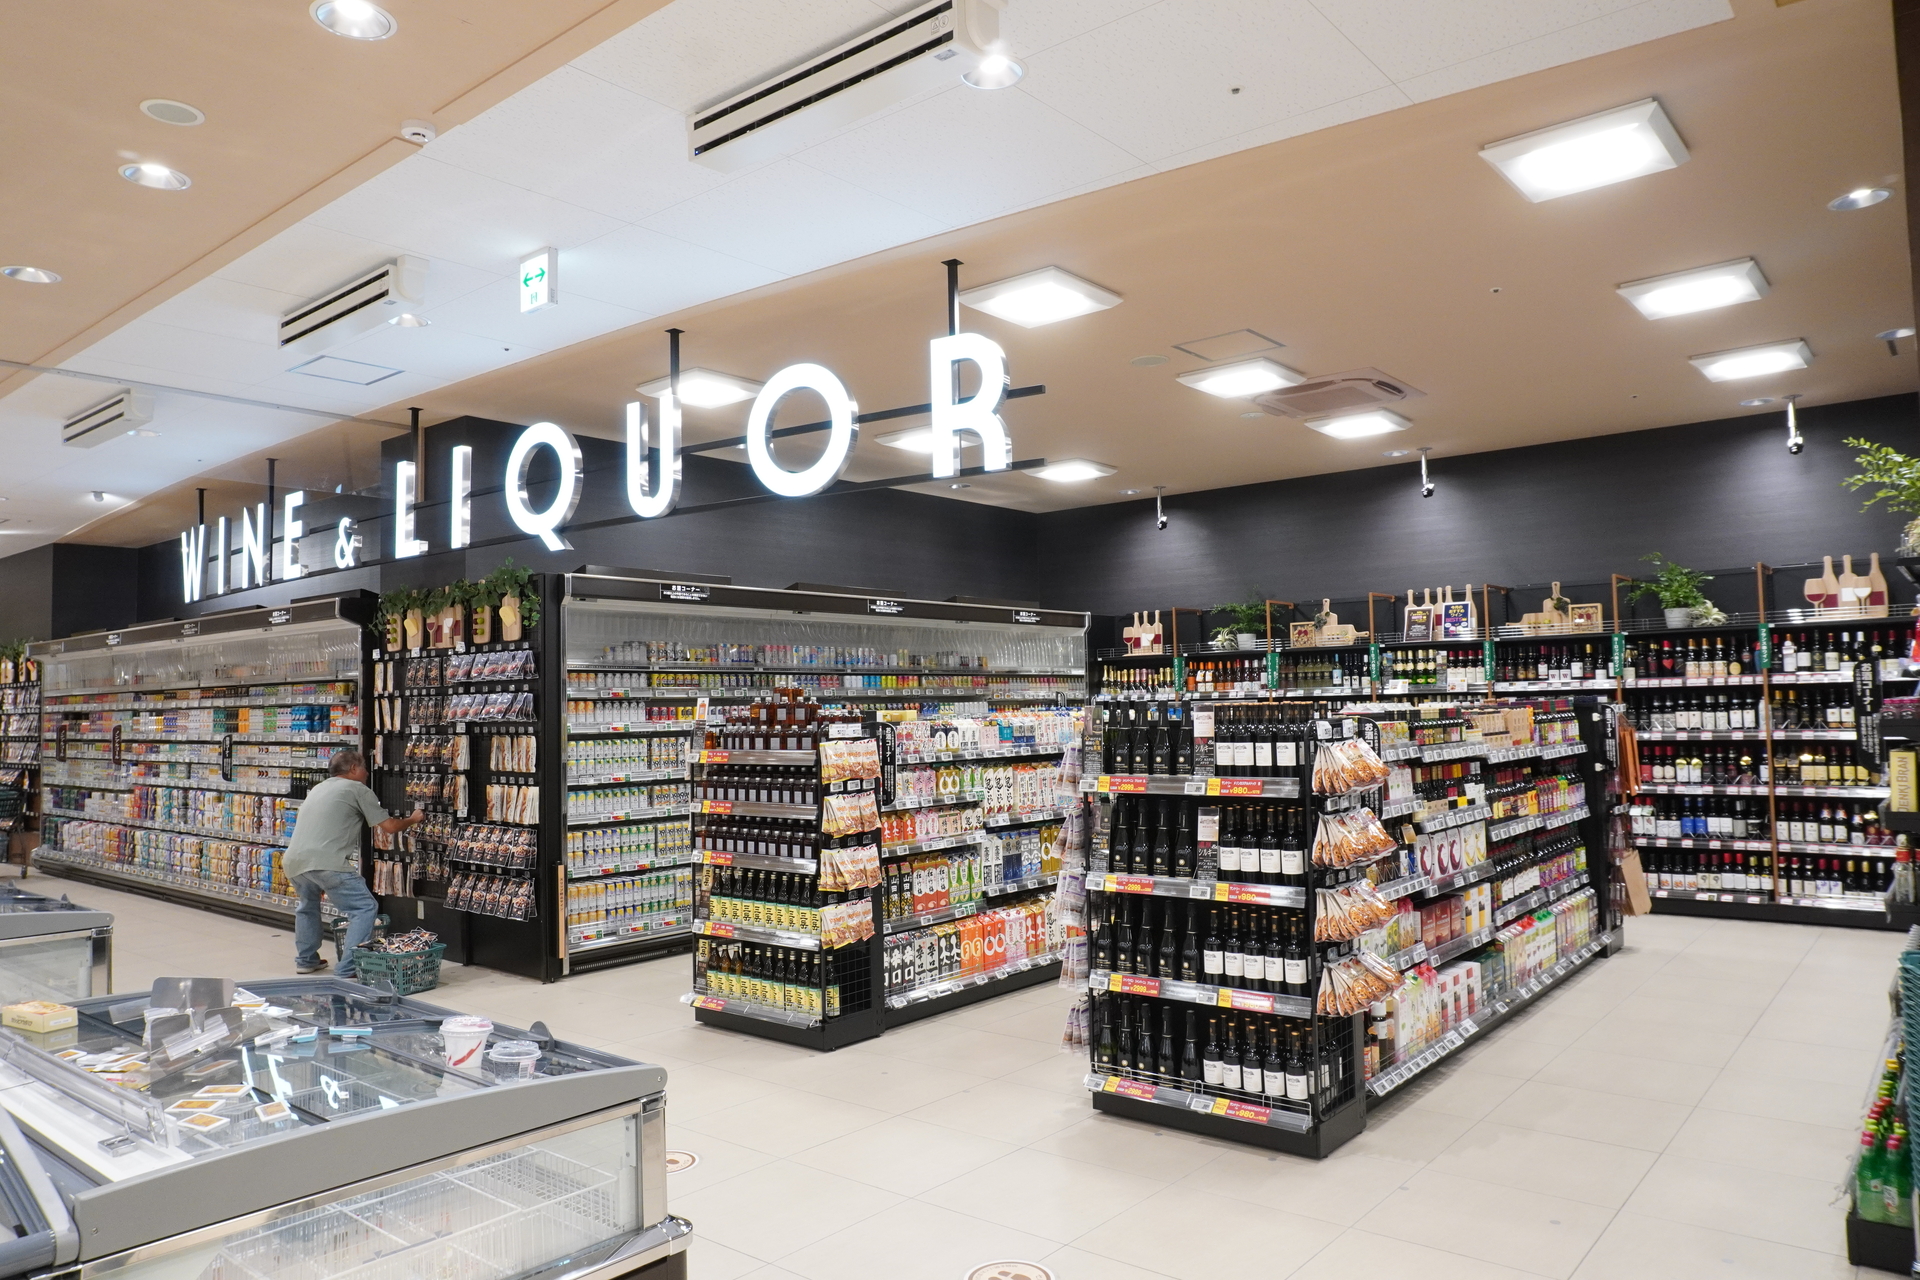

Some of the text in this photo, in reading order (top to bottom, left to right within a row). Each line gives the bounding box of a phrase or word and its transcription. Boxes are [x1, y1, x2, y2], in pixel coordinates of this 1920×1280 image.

[180, 332, 1012, 603] WINE & LIQUOR
[1861, 662, 1874, 712] お酒コーナー
[1195, 745, 1213, 753] シルキー
[1896, 756, 1910, 783] BRAN
[1198, 849, 1217, 857] シルキー
[1238, 893, 1256, 901] ¥980
[890, 948, 902, 984] 辛口
[902, 945, 915, 981] 辛口
[1235, 1109, 1255, 1119] ¥980
